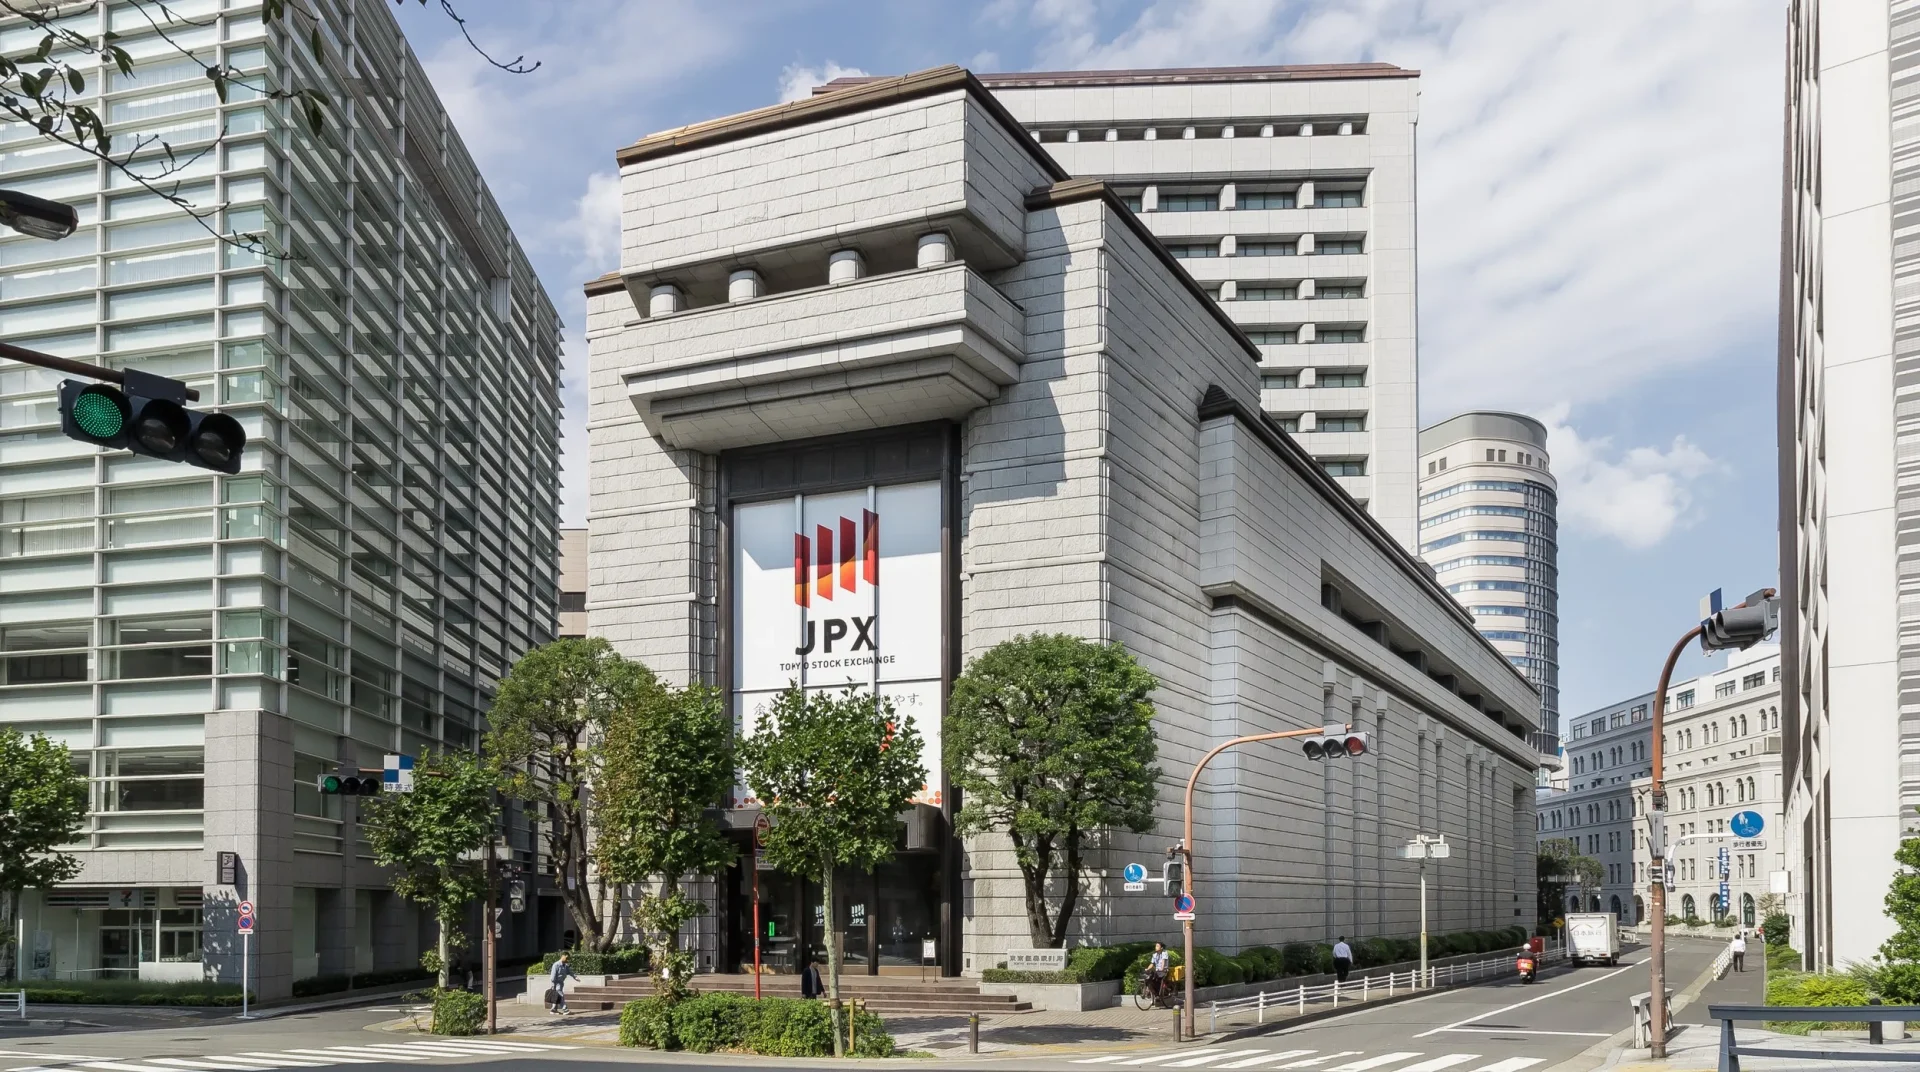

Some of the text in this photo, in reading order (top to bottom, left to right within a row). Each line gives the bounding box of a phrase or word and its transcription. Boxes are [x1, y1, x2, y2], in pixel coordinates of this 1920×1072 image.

[795, 615, 879, 655] JPX
[780, 655, 895, 671] TOKYO STOCK EXCHANGE
[385, 783, 412, 792] 時差式
[1733, 840, 1763, 848] 歩行者優先
